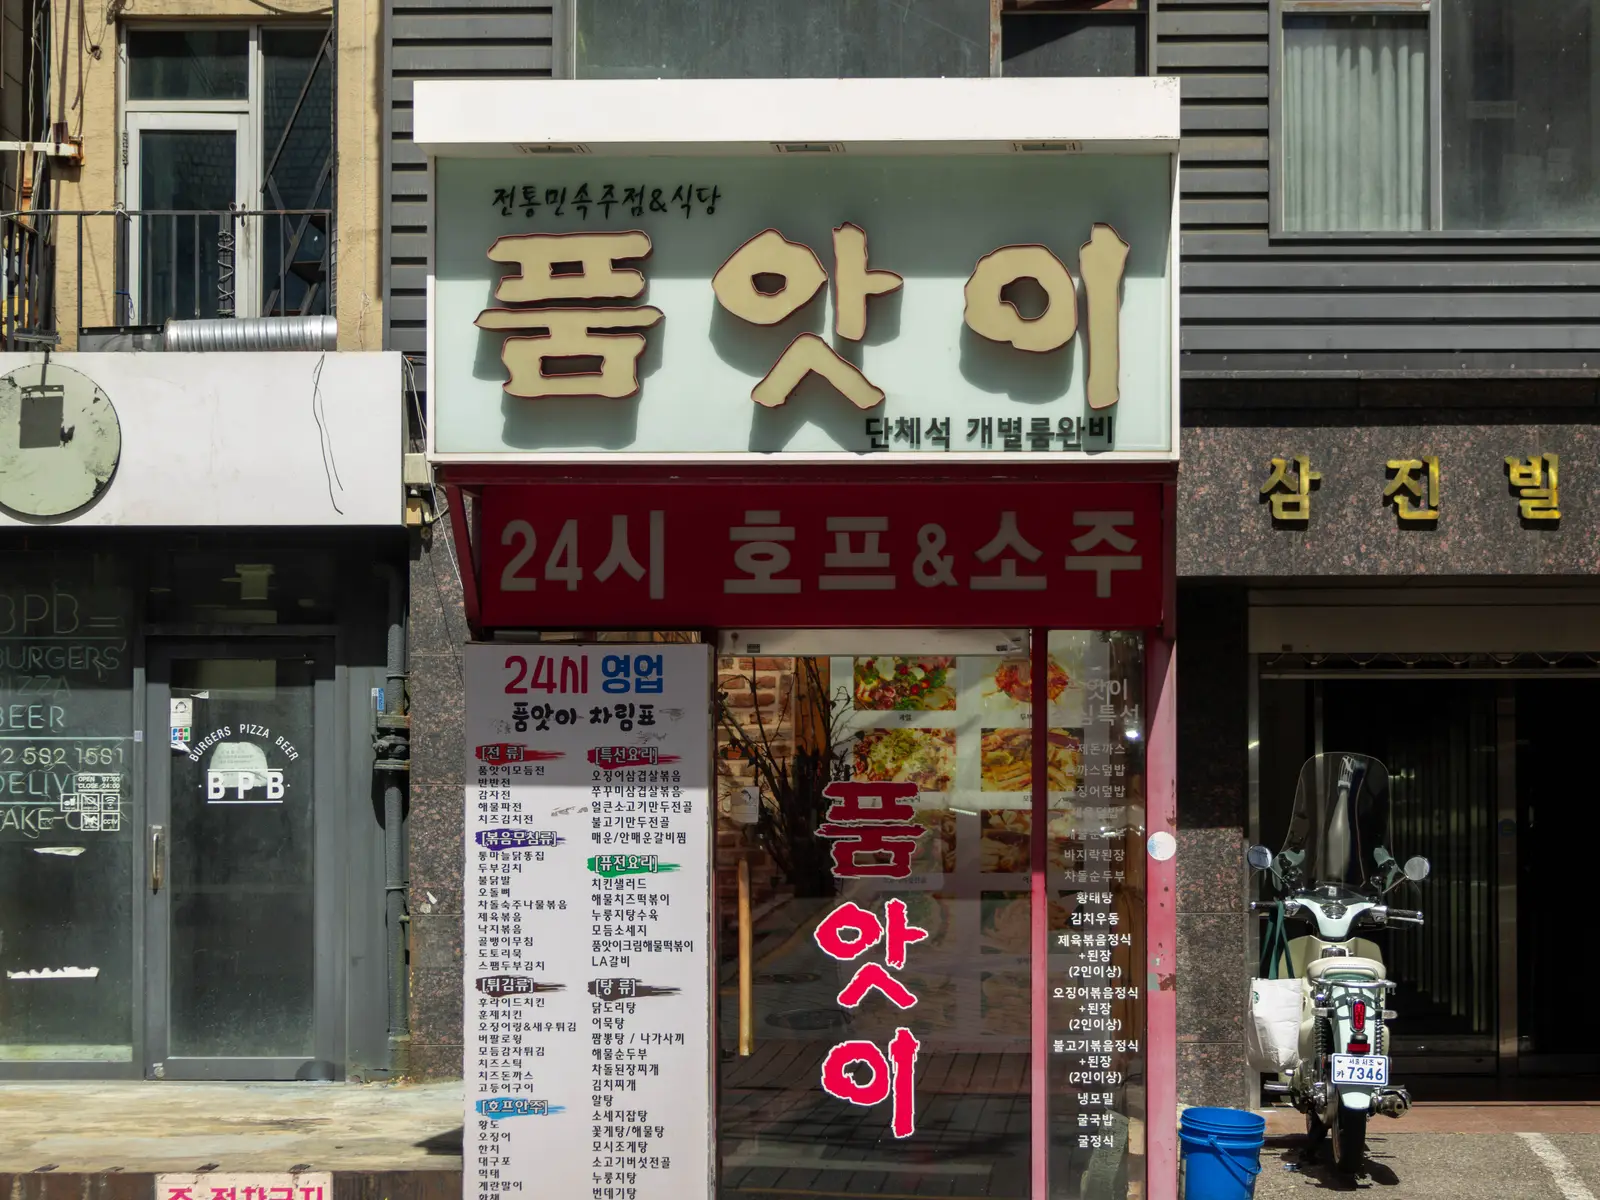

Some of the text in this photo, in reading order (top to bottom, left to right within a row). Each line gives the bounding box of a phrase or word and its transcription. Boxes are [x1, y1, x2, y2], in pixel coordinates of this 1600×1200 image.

[492, 183, 722, 220] 전통민속주점&식당
[473, 220, 1130, 409] 품앗이
[865, 416, 1113, 451] 단체석 개별룸완비
[500, 509, 1143, 599] 24시 호프&소주
[0, 645, 120, 670] URGERS
[504, 654, 664, 694] 24시 영업
[0, 675, 72, 697] IZZA
[512, 702, 656, 732] 품앗이 차림표
[188, 726, 232, 762] BURGERS
[239, 723, 270, 739] PIZZA
[275, 736, 299, 761] BEER
[595, 747, 658, 765] [특선요리]
[478, 765, 545, 776] 품앗이모듬전
[592, 770, 681, 782] 오징어삼겹살볶음
[207, 771, 285, 800] BPB
[478, 778, 511, 788] 반반전
[478, 790, 511, 800] 감자전
[592, 786, 681, 798] 쭈꾸미삼겹살볶음
[478, 802, 522, 812] 해물파전
[592, 801, 692, 813] 얼큰소고기만두전골
[478, 814, 534, 825] 치즈김치전
[592, 817, 670, 828] 불고기만두전골
[481, 831, 557, 847] [볶음무침류]
[592, 832, 686, 844] 매운/안매운갈비찜
[1064, 849, 1126, 862] 바지락된장
[478, 863, 522, 873] 두부김치
[478, 875, 511, 885] 불닭발
[1064, 870, 1126, 883] 차돌순두부
[592, 878, 647, 890] 치킨샐러드
[592, 894, 670, 906] 해물치즈떡볶이
[1076, 891, 1113, 904] 황태탕
[478, 912, 522, 922] 제육볶음
[592, 909, 659, 921] 누룽지탕수육
[1070, 912, 1120, 925] 김치우동
[478, 924, 522, 934] 낙지볶음
[592, 925, 647, 936] 모듬소세지
[478, 937, 534, 947] 골뱅이무침
[592, 940, 694, 952] 품앗이크림해물떡볶이
[1057, 933, 1131, 947] 제육볶음정식
[478, 949, 522, 958] 도토리묵
[814, 781, 928, 1138] 품앗이
[478, 961, 545, 971] 스팸두부김치
[592, 956, 630, 967] LA갈비
[1068, 965, 1122, 978] (2인이상)
[481, 978, 534, 994] [튀김류]
[1052, 987, 1138, 999] 오징어볶음정식
[478, 998, 545, 1008] 후라이드치킨
[592, 1002, 636, 1014] 닭도리탕
[478, 1010, 522, 1020] 훈제치킨
[478, 1022, 577, 1032] 오징어링&새우튀김
[592, 1018, 625, 1029] 어묵탕
[1068, 1018, 1122, 1031] (2인이상)
[592, 1033, 625, 1045] 짬뽕탕
[640, 1033, 685, 1045] 나가사끼
[478, 1046, 545, 1056] 모듬감자튀김
[1053, 1039, 1138, 1052] 불고기볶음정식
[592, 1048, 647, 1060] 해물순두부
[478, 1059, 522, 1069] 치즈스틱
[592, 1064, 659, 1076] 차돌된장찌개
[478, 1071, 534, 1081] 치즈돈까스
[1068, 1071, 1122, 1084] (2인이상)
[1347, 1067, 1383, 1080] 7346
[478, 1083, 534, 1093] 고등어구이
[592, 1079, 636, 1091] 김치찌개
[592, 1095, 614, 1107] 알탕
[1077, 1092, 1114, 1105] 냉모밀
[481, 1100, 548, 1116] [호프안주]
[592, 1110, 648, 1122] 소세지잡탕
[1077, 1113, 1114, 1126] 굴국밥
[478, 1120, 499, 1130] 황도
[478, 1132, 511, 1142] 오징어
[592, 1126, 665, 1138] 꽃게탕/해물탕
[1077, 1134, 1114, 1147] 굴정식
[478, 1144, 499, 1154] 한치
[478, 1156, 511, 1166] 대구포
[592, 1157, 670, 1169] 소고기버섯전골
[478, 1169, 500, 1179] 먹태
[592, 1172, 636, 1184] 누룽지탕
[592, 1188, 636, 1200] 번데기탕
